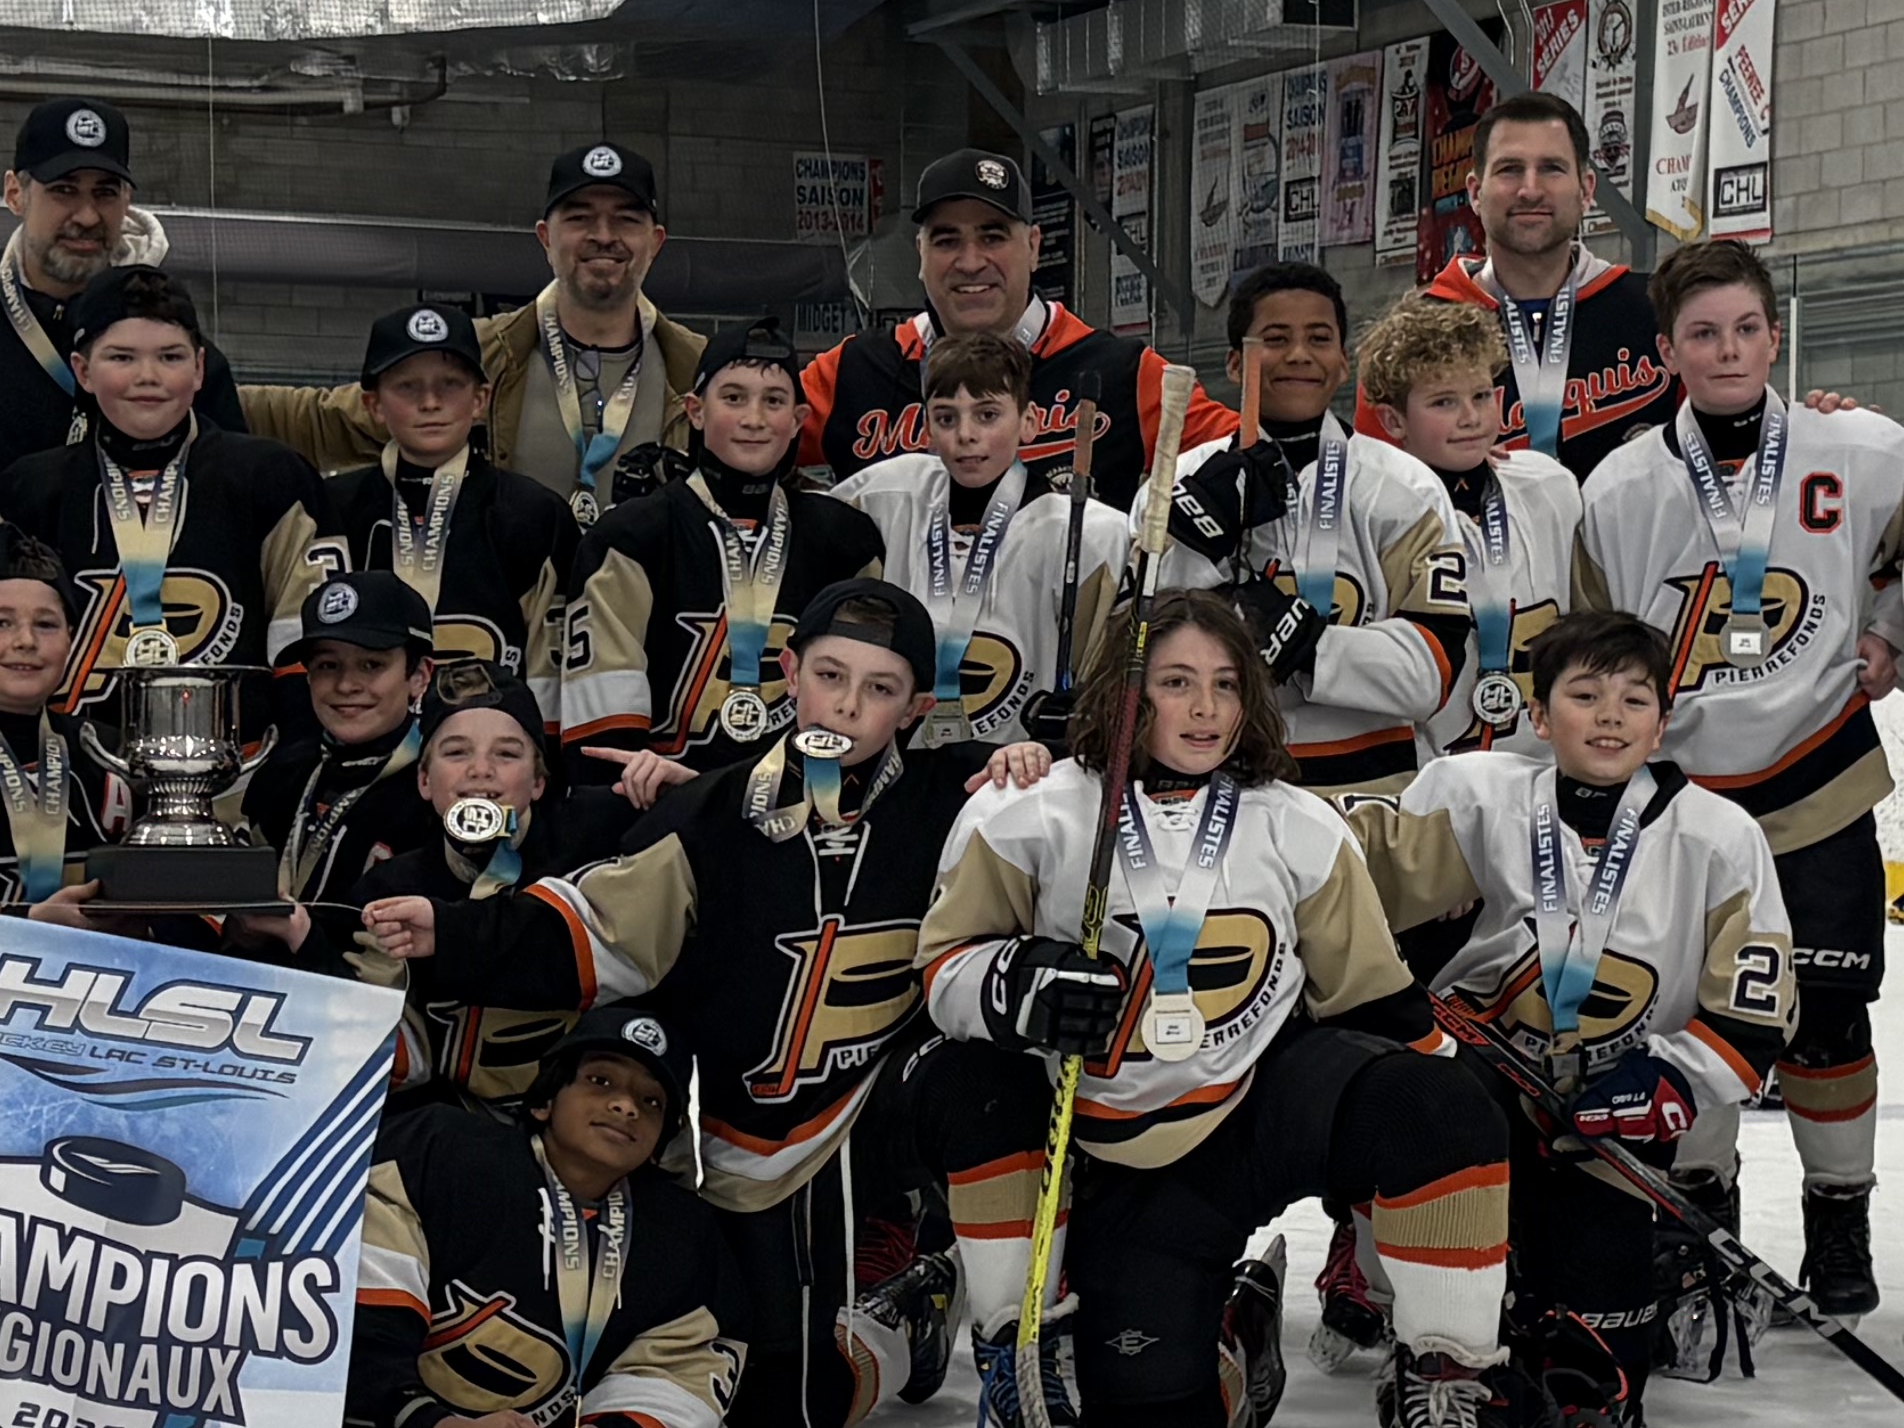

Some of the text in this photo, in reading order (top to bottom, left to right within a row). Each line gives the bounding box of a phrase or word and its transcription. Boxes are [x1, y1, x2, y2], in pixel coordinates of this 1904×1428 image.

[797, 185, 865, 206] SAISON
[1721, 175, 1763, 206] CHL
[1687, 432, 1726, 519] FINALISTES
[1799, 471, 1844, 534] C
[423, 474, 455, 572] CHAMPIONS
[967, 502, 1009, 595] FINALISTES
[1425, 549, 1470, 608] 2
[1714, 593, 1826, 684] PIERREFONDS
[976, 670, 1036, 737] EFONDS
[101, 771, 134, 834] A
[1538, 803, 1559, 912] FINALISTES
[1592, 808, 1637, 915] FINALISTES
[1729, 942, 1784, 1018] 2
[90, 1044, 144, 1062] LAC
[150, 1054, 298, 1085] ST-LOUIS
[1708, 1227, 1848, 1339] CCM
